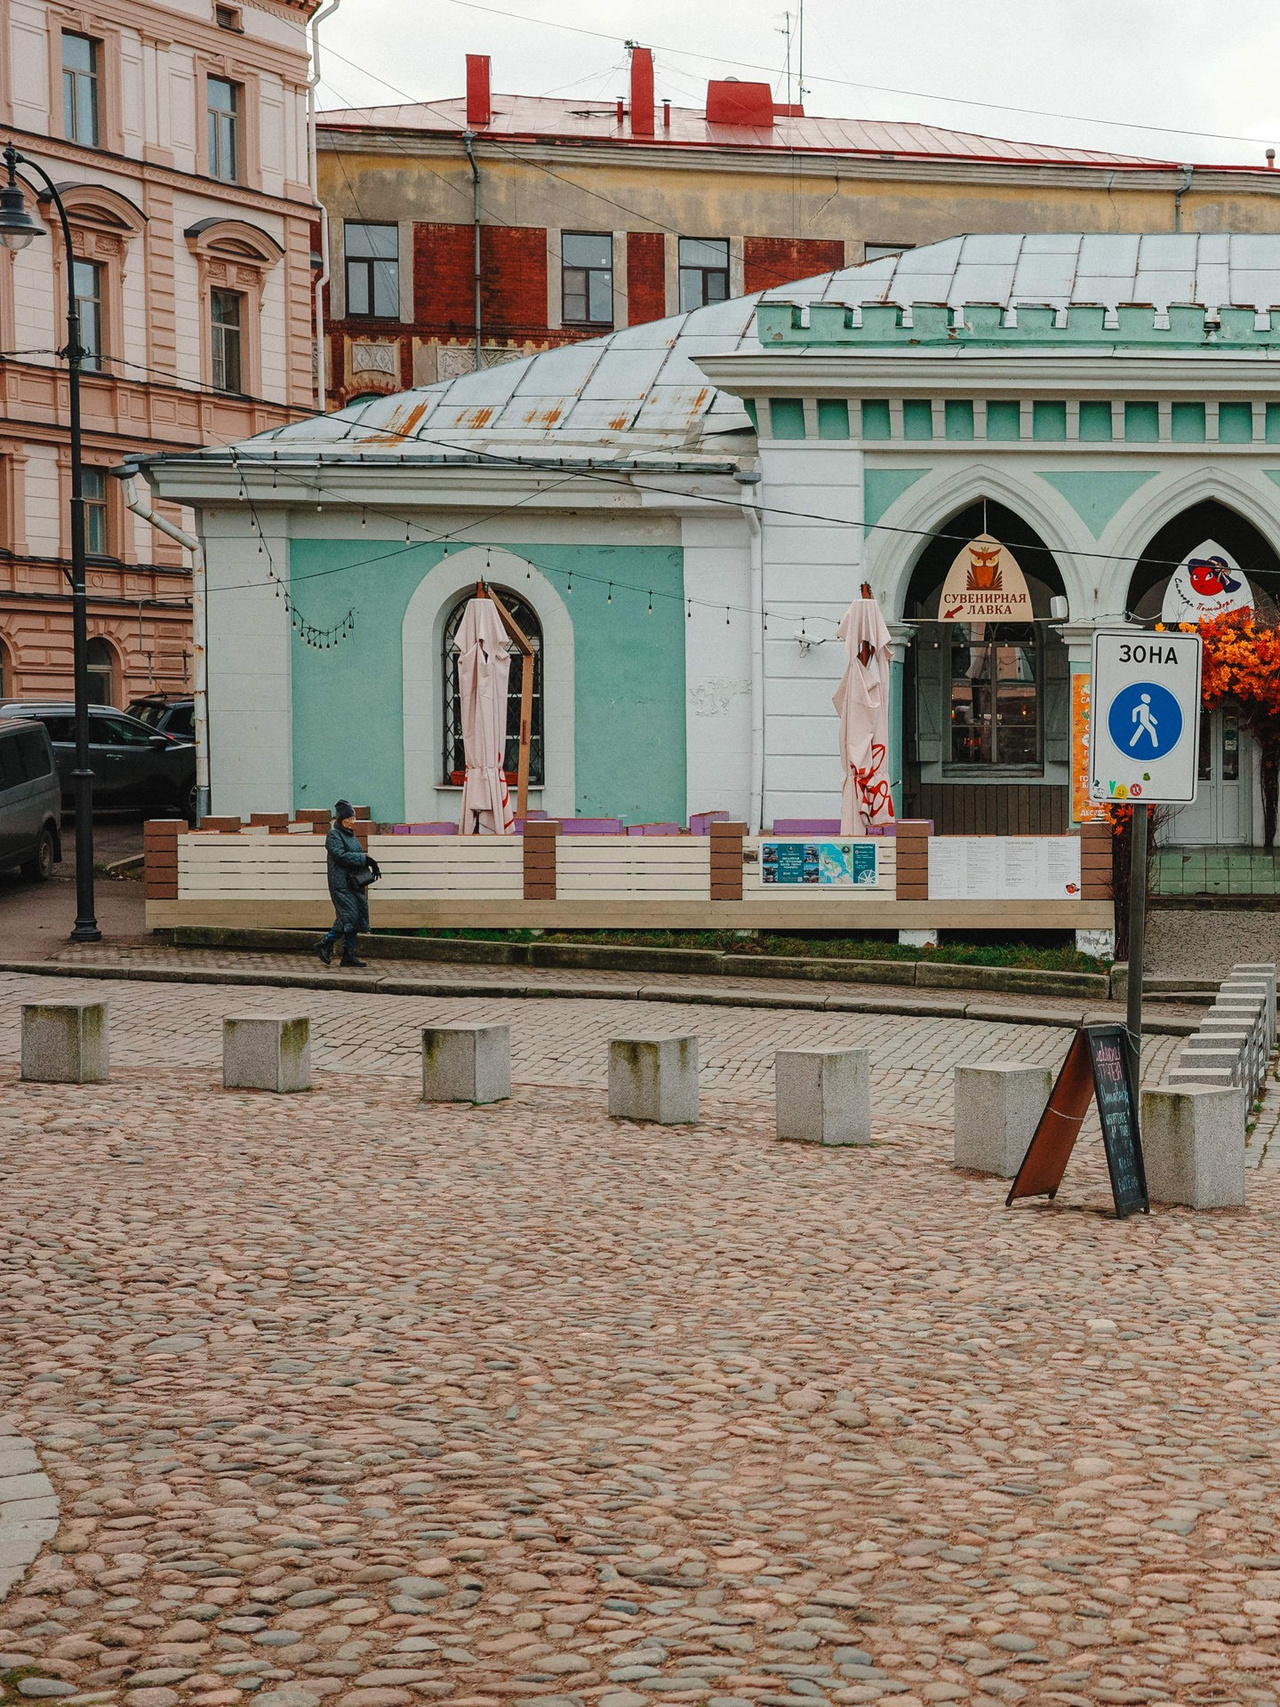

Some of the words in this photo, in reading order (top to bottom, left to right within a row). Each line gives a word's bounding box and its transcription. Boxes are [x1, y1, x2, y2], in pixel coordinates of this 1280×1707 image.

[943, 593, 1027, 604] СУВЕНИРНАЯ
[967, 604, 1012, 615] ЛАВКА
[1118, 644, 1179, 665] ЗОНА
